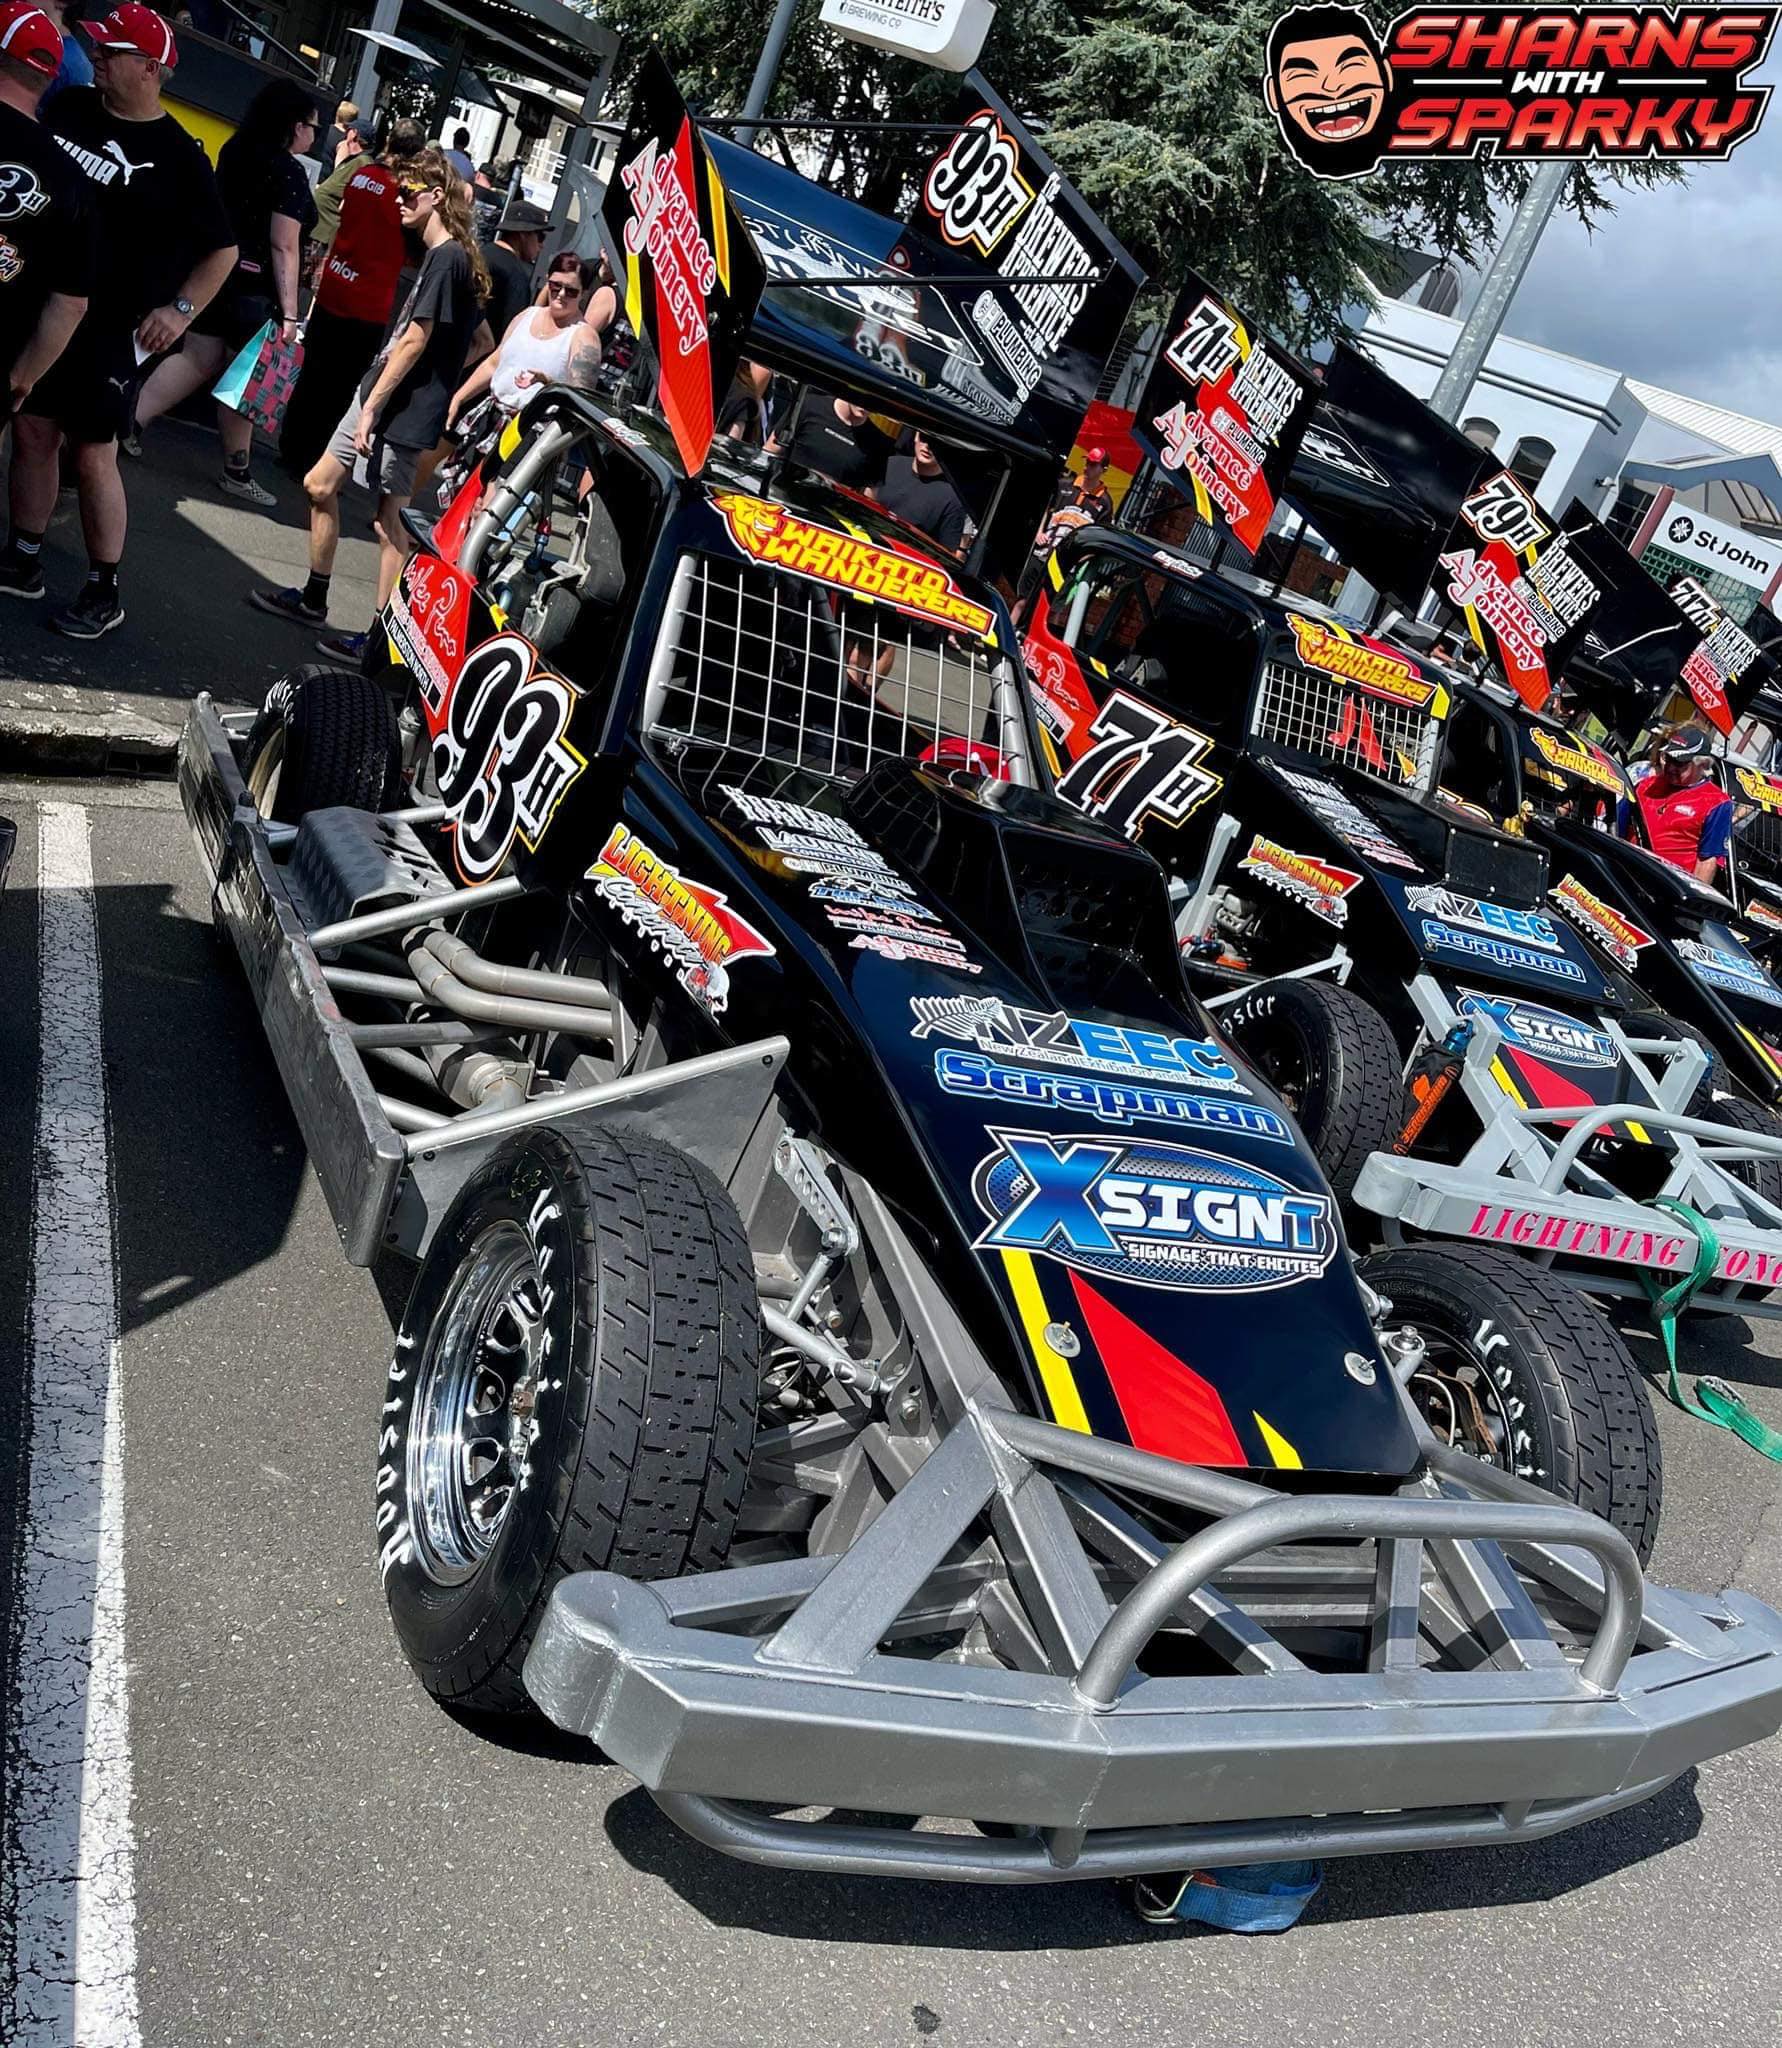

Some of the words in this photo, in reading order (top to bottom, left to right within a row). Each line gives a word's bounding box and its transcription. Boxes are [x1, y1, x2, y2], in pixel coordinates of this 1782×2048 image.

[849, 6, 888, 26] BREWING
[367, 180, 385, 195] GIB
[620, 136, 716, 295] Advance
[928, 113, 1032, 250] 93H
[624, 195, 708, 355] Joinery
[1016, 194, 1100, 316] BREWERS
[998, 240, 1074, 353] APPRENTICE
[991, 315, 1043, 390] PLUMBING
[1166, 297, 1242, 384] 71H
[1227, 374, 1288, 442] APPRENTICE
[1239, 343, 1304, 417] BREWERS
[1153, 400, 1252, 490] Advance
[1228, 421, 1266, 466] PLUMBING
[1161, 434, 1249, 524] Joinery
[1461, 474, 1548, 551] 79H
[783, 521, 946, 595] WAIKATO
[1556, 531, 1570, 548] The
[1694, 530, 1718, 551] St
[1717, 541, 1770, 575] John
[762, 536, 990, 633] WANDERERS
[1438, 549, 1547, 648] Advance
[1525, 561, 1585, 628] APPRENTICE
[1540, 542, 1601, 612] BREWERS
[1448, 578, 1544, 671] Joinery
[1528, 593, 1567, 639] PLUMBING
[1715, 616, 1762, 666] BREWERS
[1311, 650, 1433, 703] WANDERERS
[1326, 637, 1411, 679] WAIKATO
[1705, 634, 1750, 678] APPRENTICE
[433, 635, 582, 876] 93H
[1055, 692, 1218, 839] 71H
[736, 792, 855, 833] BREWERS
[744, 806, 871, 849] APPRENTICE
[599, 823, 733, 966] LIGHTNING
[821, 863, 917, 895] PLUMBING
[1249, 835, 1345, 898] LIGHTNING
[1435, 890, 1559, 945] NZEEC
[1558, 873, 1638, 949] LIGHTNING
[1424, 921, 1585, 981] Scrapman
[972, 1000, 1239, 1084] NZEEC
[980, 1038, 1015, 1057] New
[1017, 1043, 1079, 1067] Zealand
[1080, 1054, 1151, 1079] Exhibition
[1182, 1070, 1229, 1091] Events
[940, 1052, 1290, 1142] Scrapman
[1128, 1241, 1201, 1265] SIGNAGE
[1206, 1249, 1251, 1269] THAT
[1468, 1204, 1686, 1266] LIGHTNING
